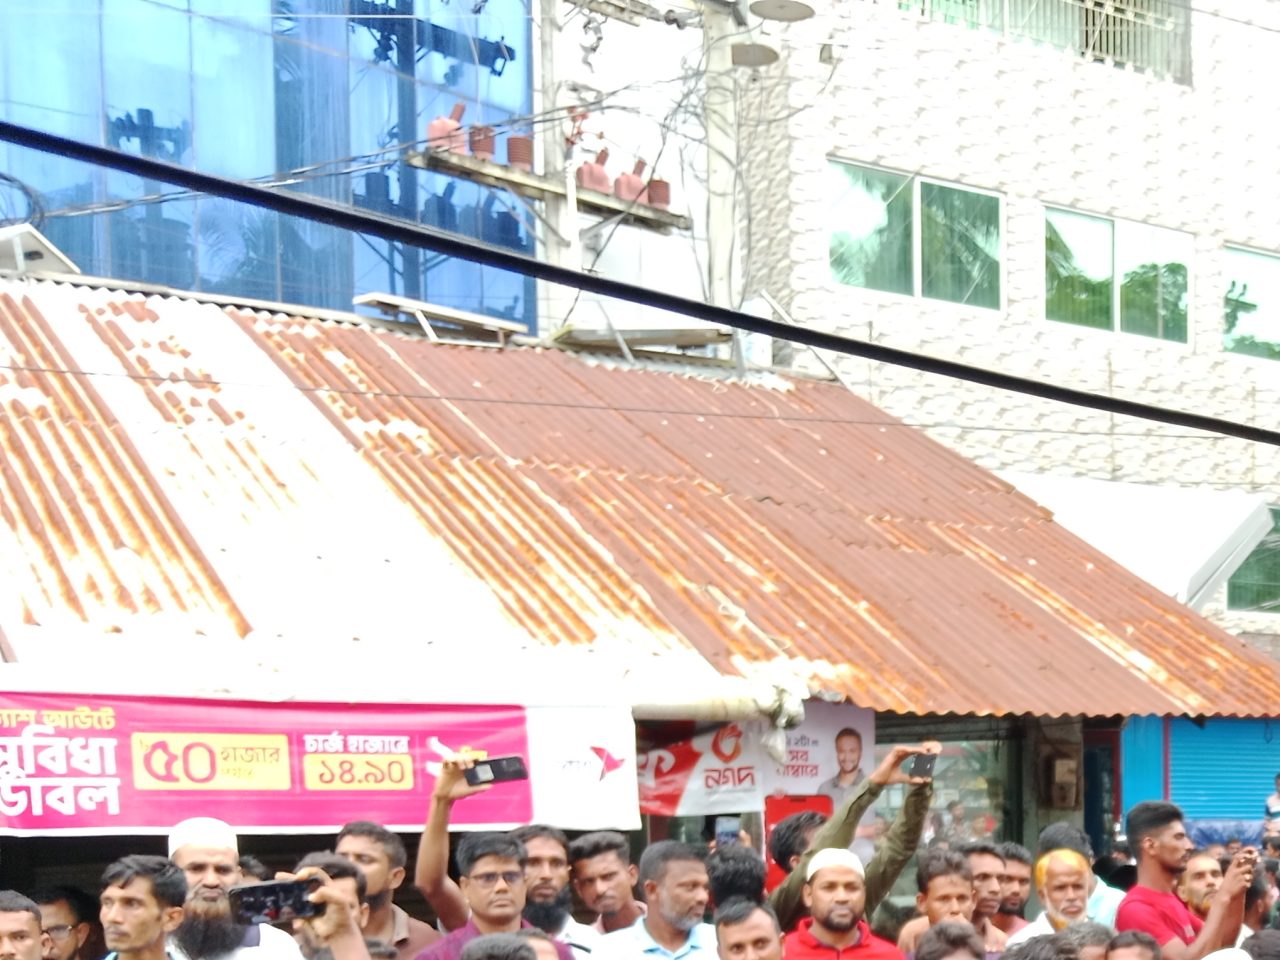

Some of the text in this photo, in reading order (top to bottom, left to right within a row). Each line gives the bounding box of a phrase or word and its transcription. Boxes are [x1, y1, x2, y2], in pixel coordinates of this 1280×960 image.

[303, 731, 344, 753] চার্জ
[220, 746, 281, 763] হাজার
[318, 760, 406, 784] ১৪.৯০
[704, 766, 756, 789] নগদ
